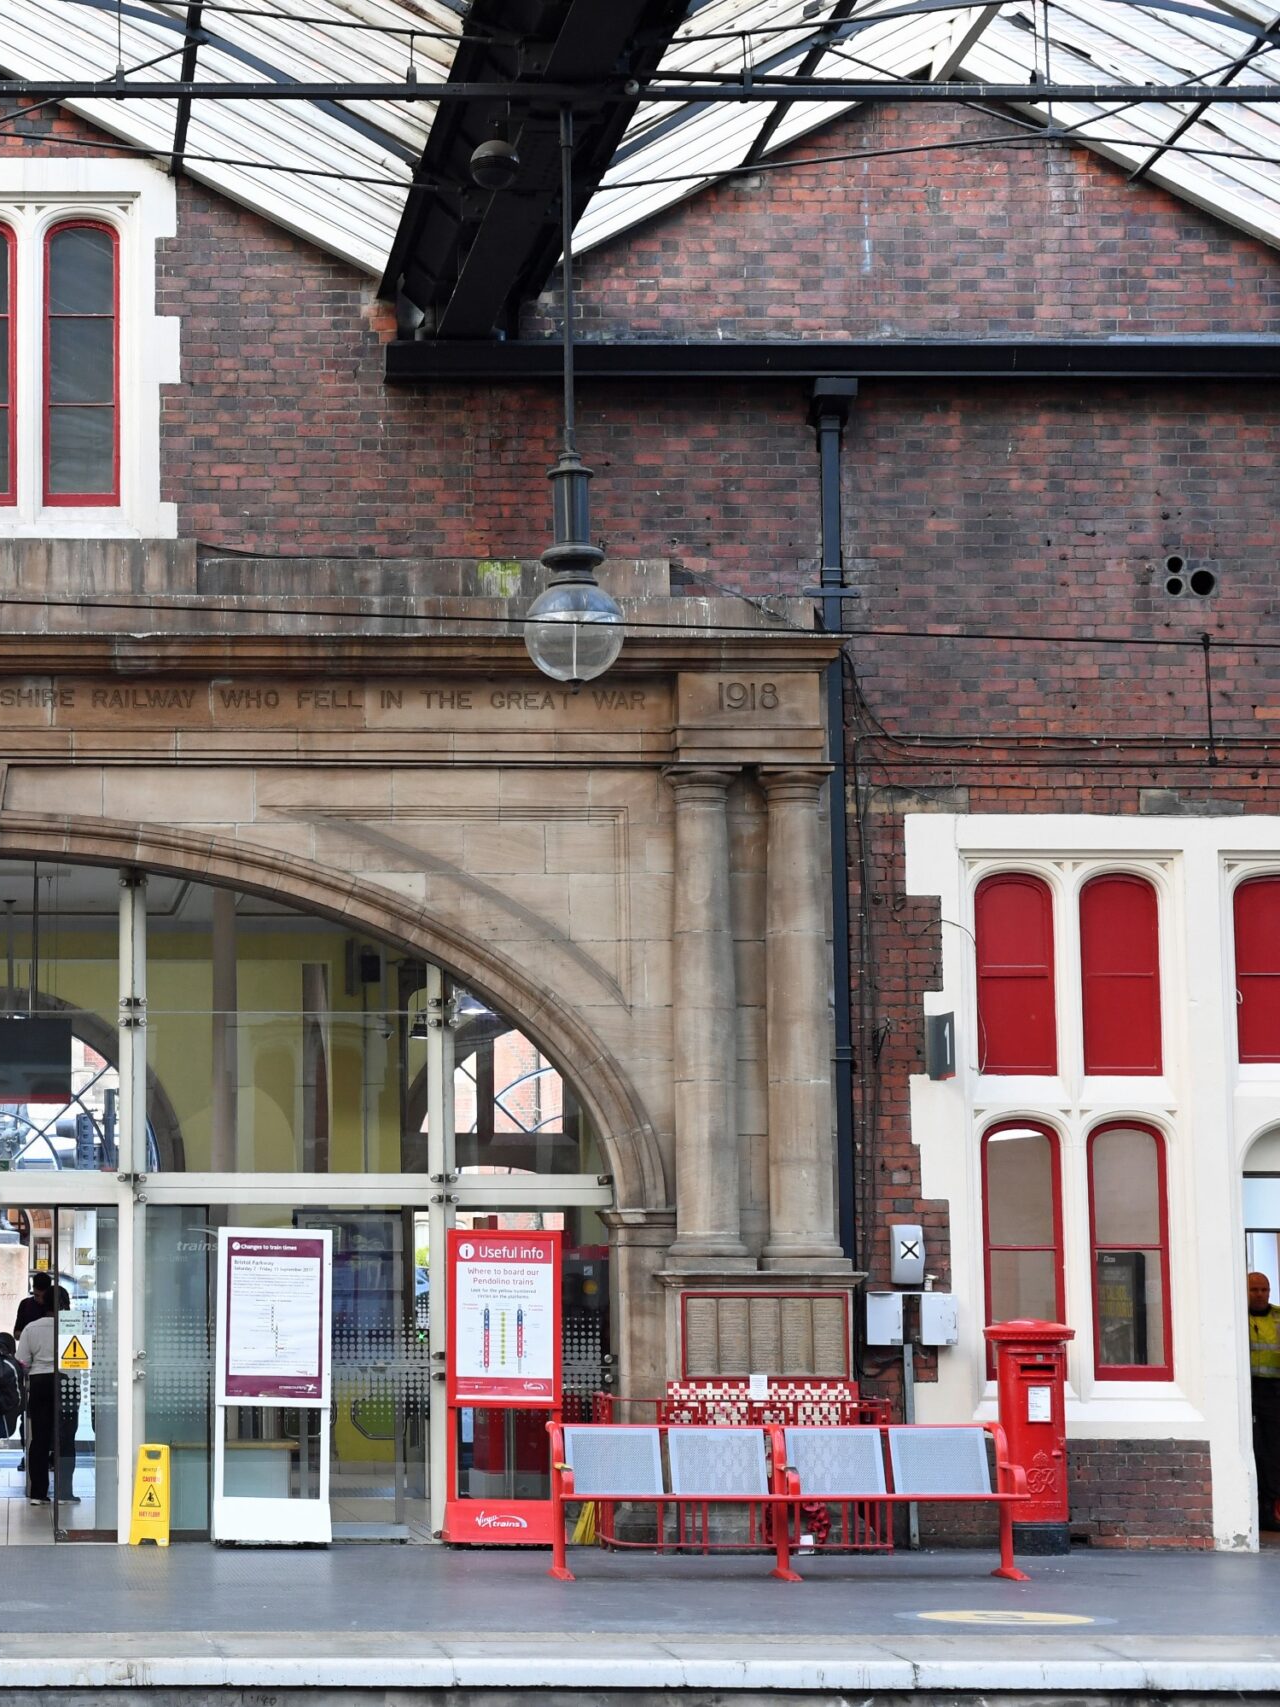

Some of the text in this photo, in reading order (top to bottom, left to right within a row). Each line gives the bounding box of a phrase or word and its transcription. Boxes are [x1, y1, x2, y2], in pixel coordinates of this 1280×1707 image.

[90, 688, 197, 709] RAILWAY
[219, 688, 280, 710] WHO
[297, 689, 363, 710] FELL
[380, 689, 404, 710] IN
[419, 689, 473, 711] THE
[489, 689, 572, 711] GREAT
[591, 690, 647, 711] WAR
[717, 681, 780, 712] 1918
[943, 1021, 951, 1065] 1
[240, 1243, 262, 1251] Changes
[479, 1246, 544, 1259] Useful info
[467, 1267, 491, 1275] Where
[473, 1277, 534, 1286] Pendolino trains
[475, 1510, 520, 1528] Virgin trains
